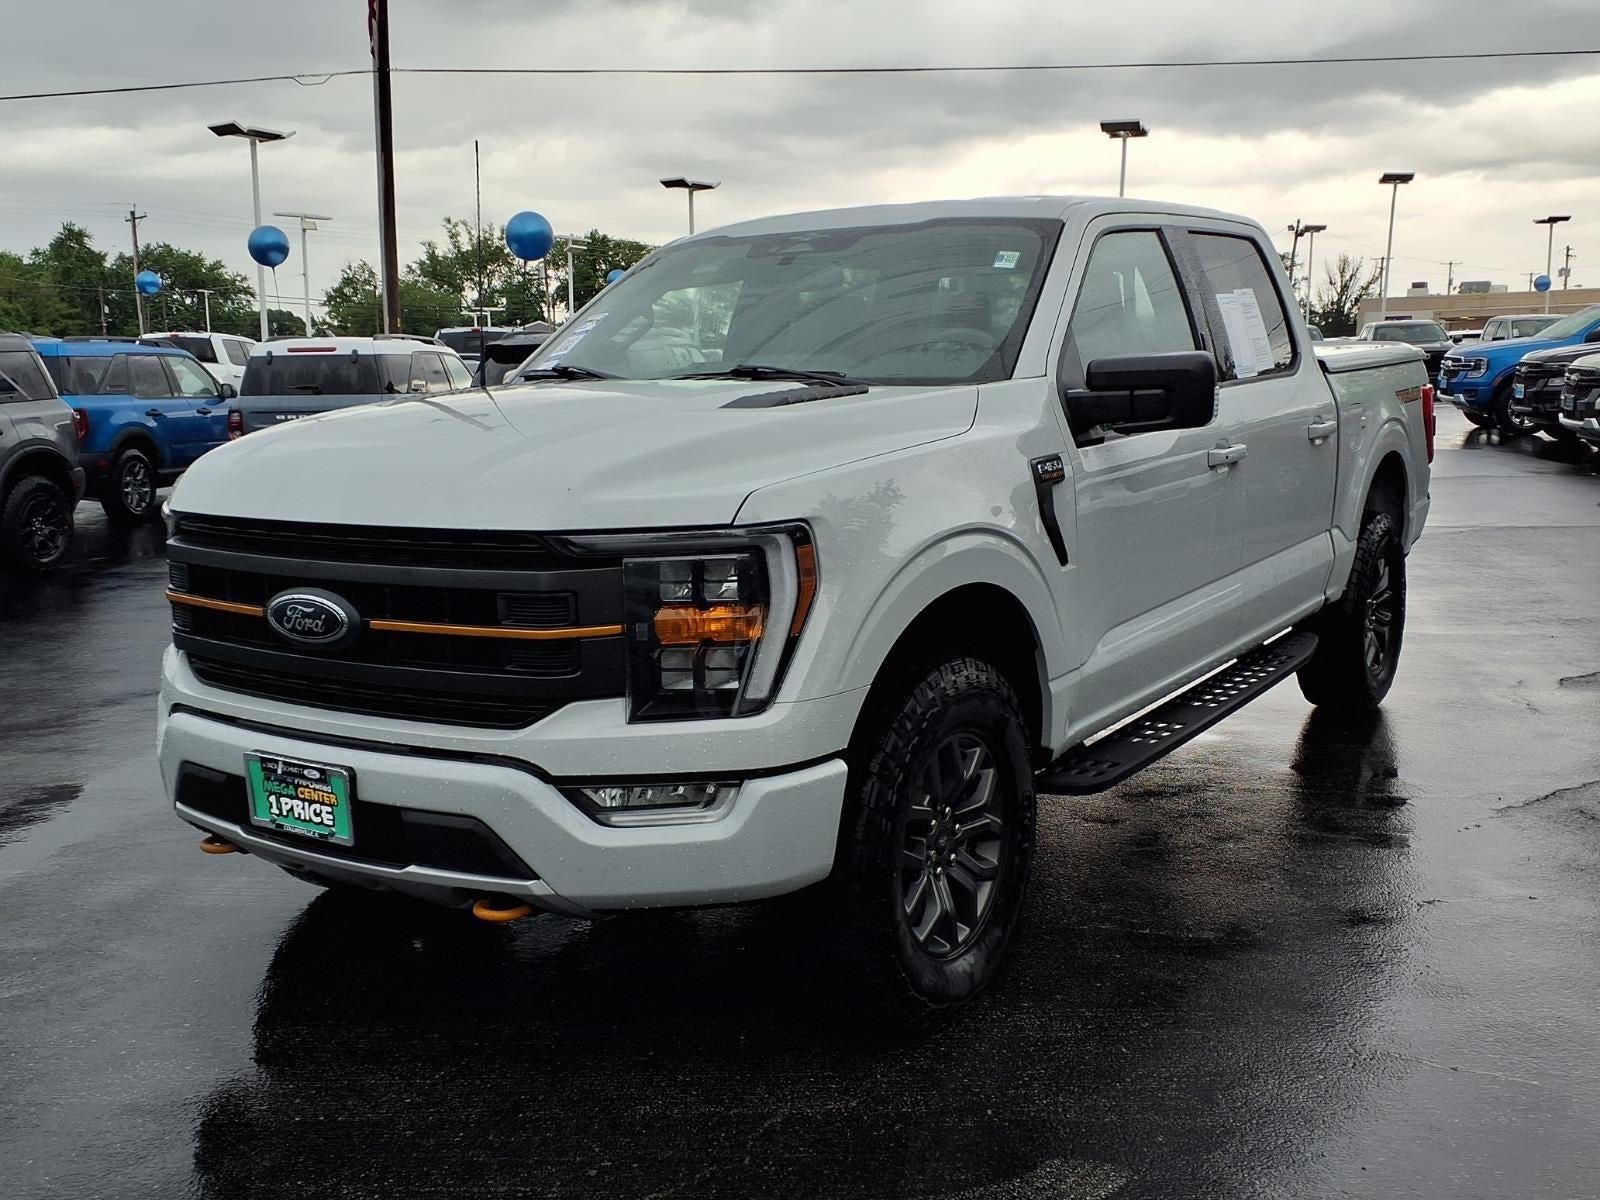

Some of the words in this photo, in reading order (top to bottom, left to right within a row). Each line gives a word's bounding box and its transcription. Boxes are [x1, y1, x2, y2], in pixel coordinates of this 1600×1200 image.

[283, 604, 326, 632] Ford
[263, 780, 296, 797] MEGA
[297, 786, 338, 806] CENTER
